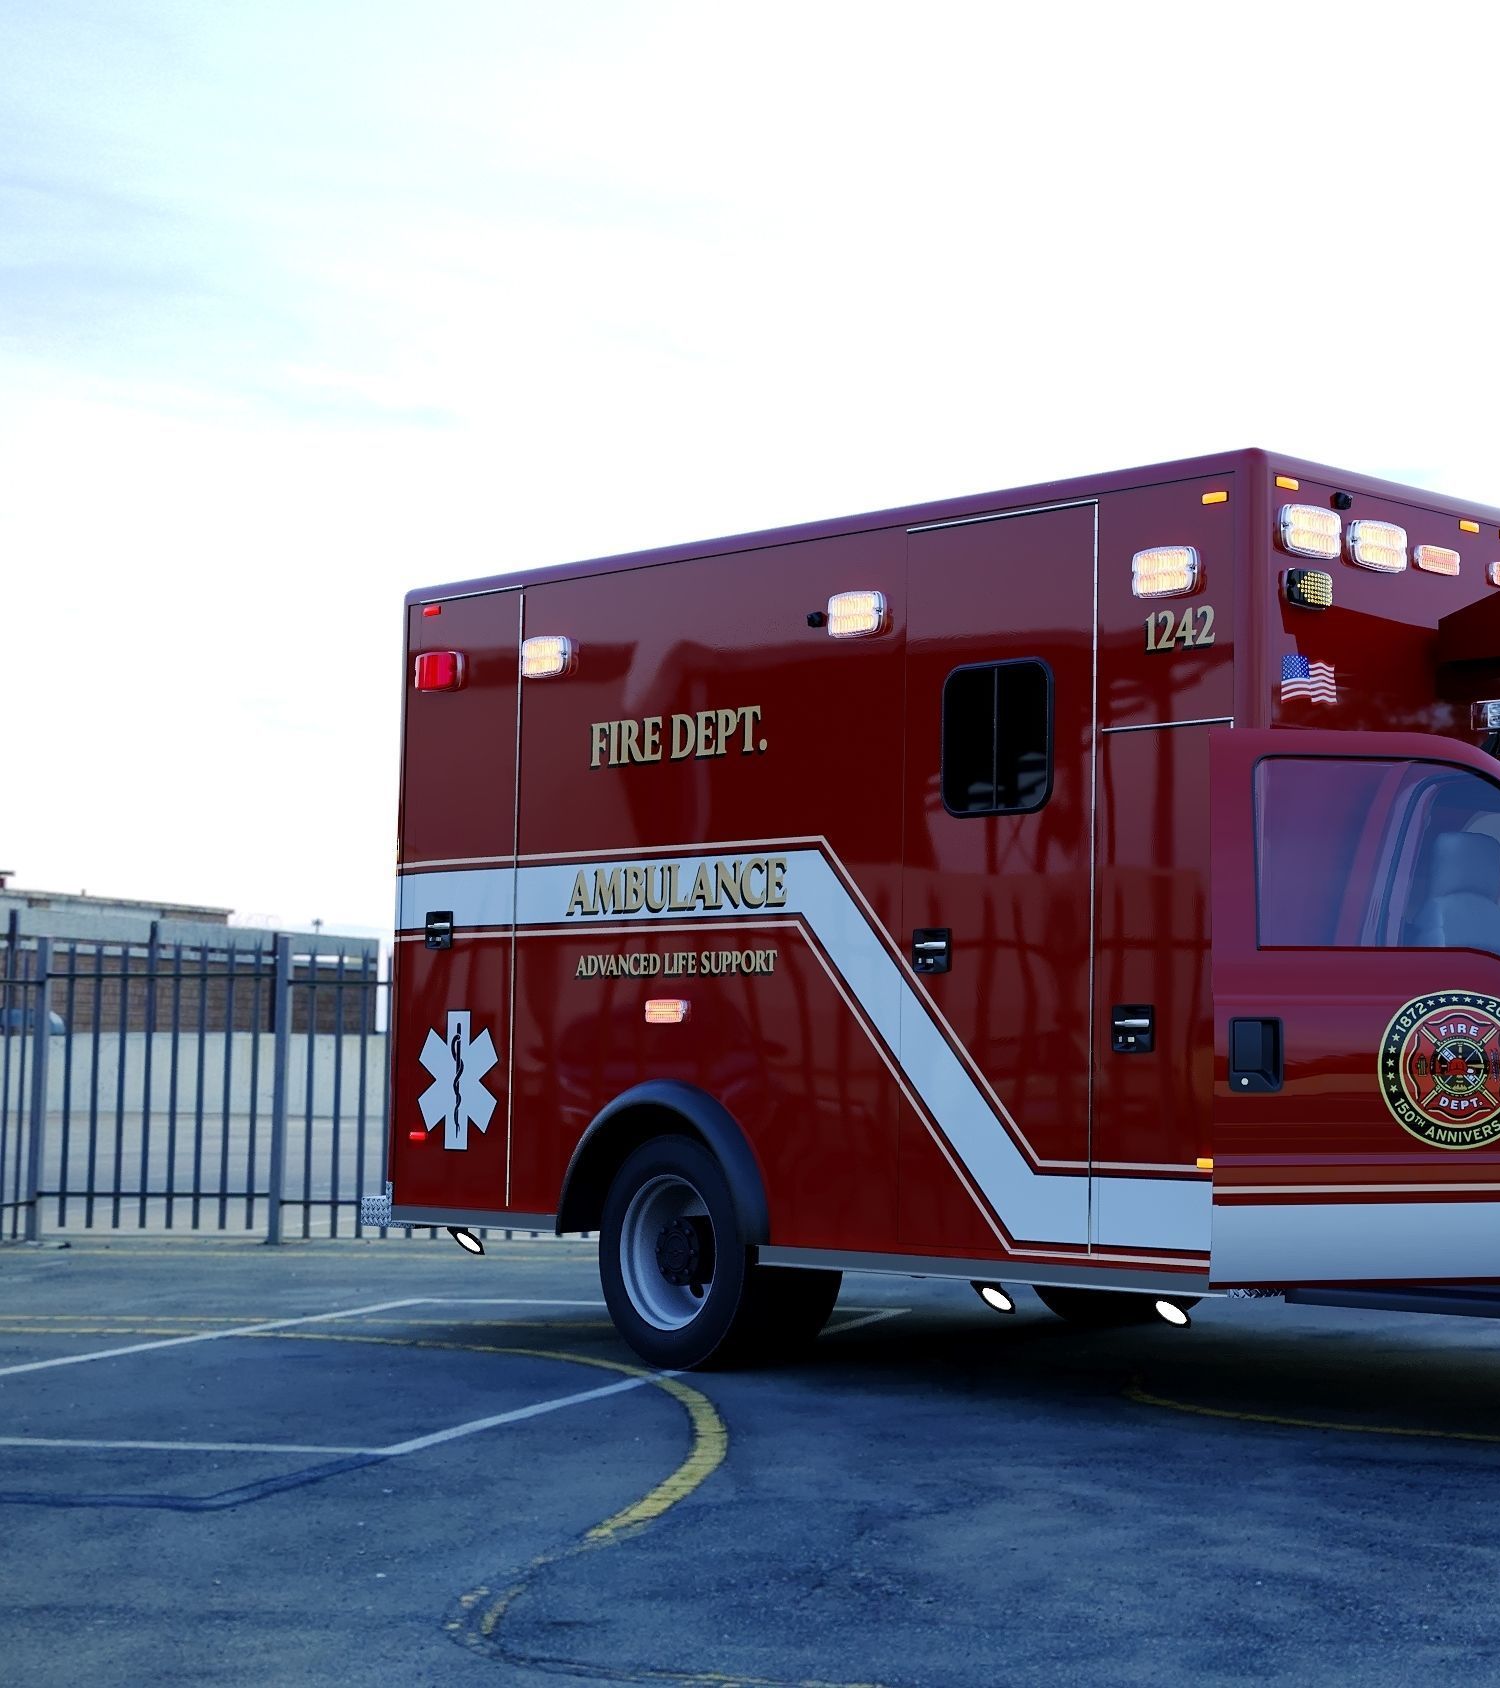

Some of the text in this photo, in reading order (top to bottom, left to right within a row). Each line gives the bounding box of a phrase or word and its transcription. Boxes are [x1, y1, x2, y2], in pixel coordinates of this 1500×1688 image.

[1145, 605, 1216, 652] 1242
[590, 705, 768, 769] FIRE DEPT.
[566, 857, 788, 917] AMBULANCE
[575, 949, 778, 979] ADVANCED LIFE SUPPORT
[1395, 1002, 1428, 1033] 1872
[1439, 1023, 1480, 1037] FIRE
[1394, 1097, 1426, 1128] 150TH
[1438, 1096, 1484, 1110] DEPT.
